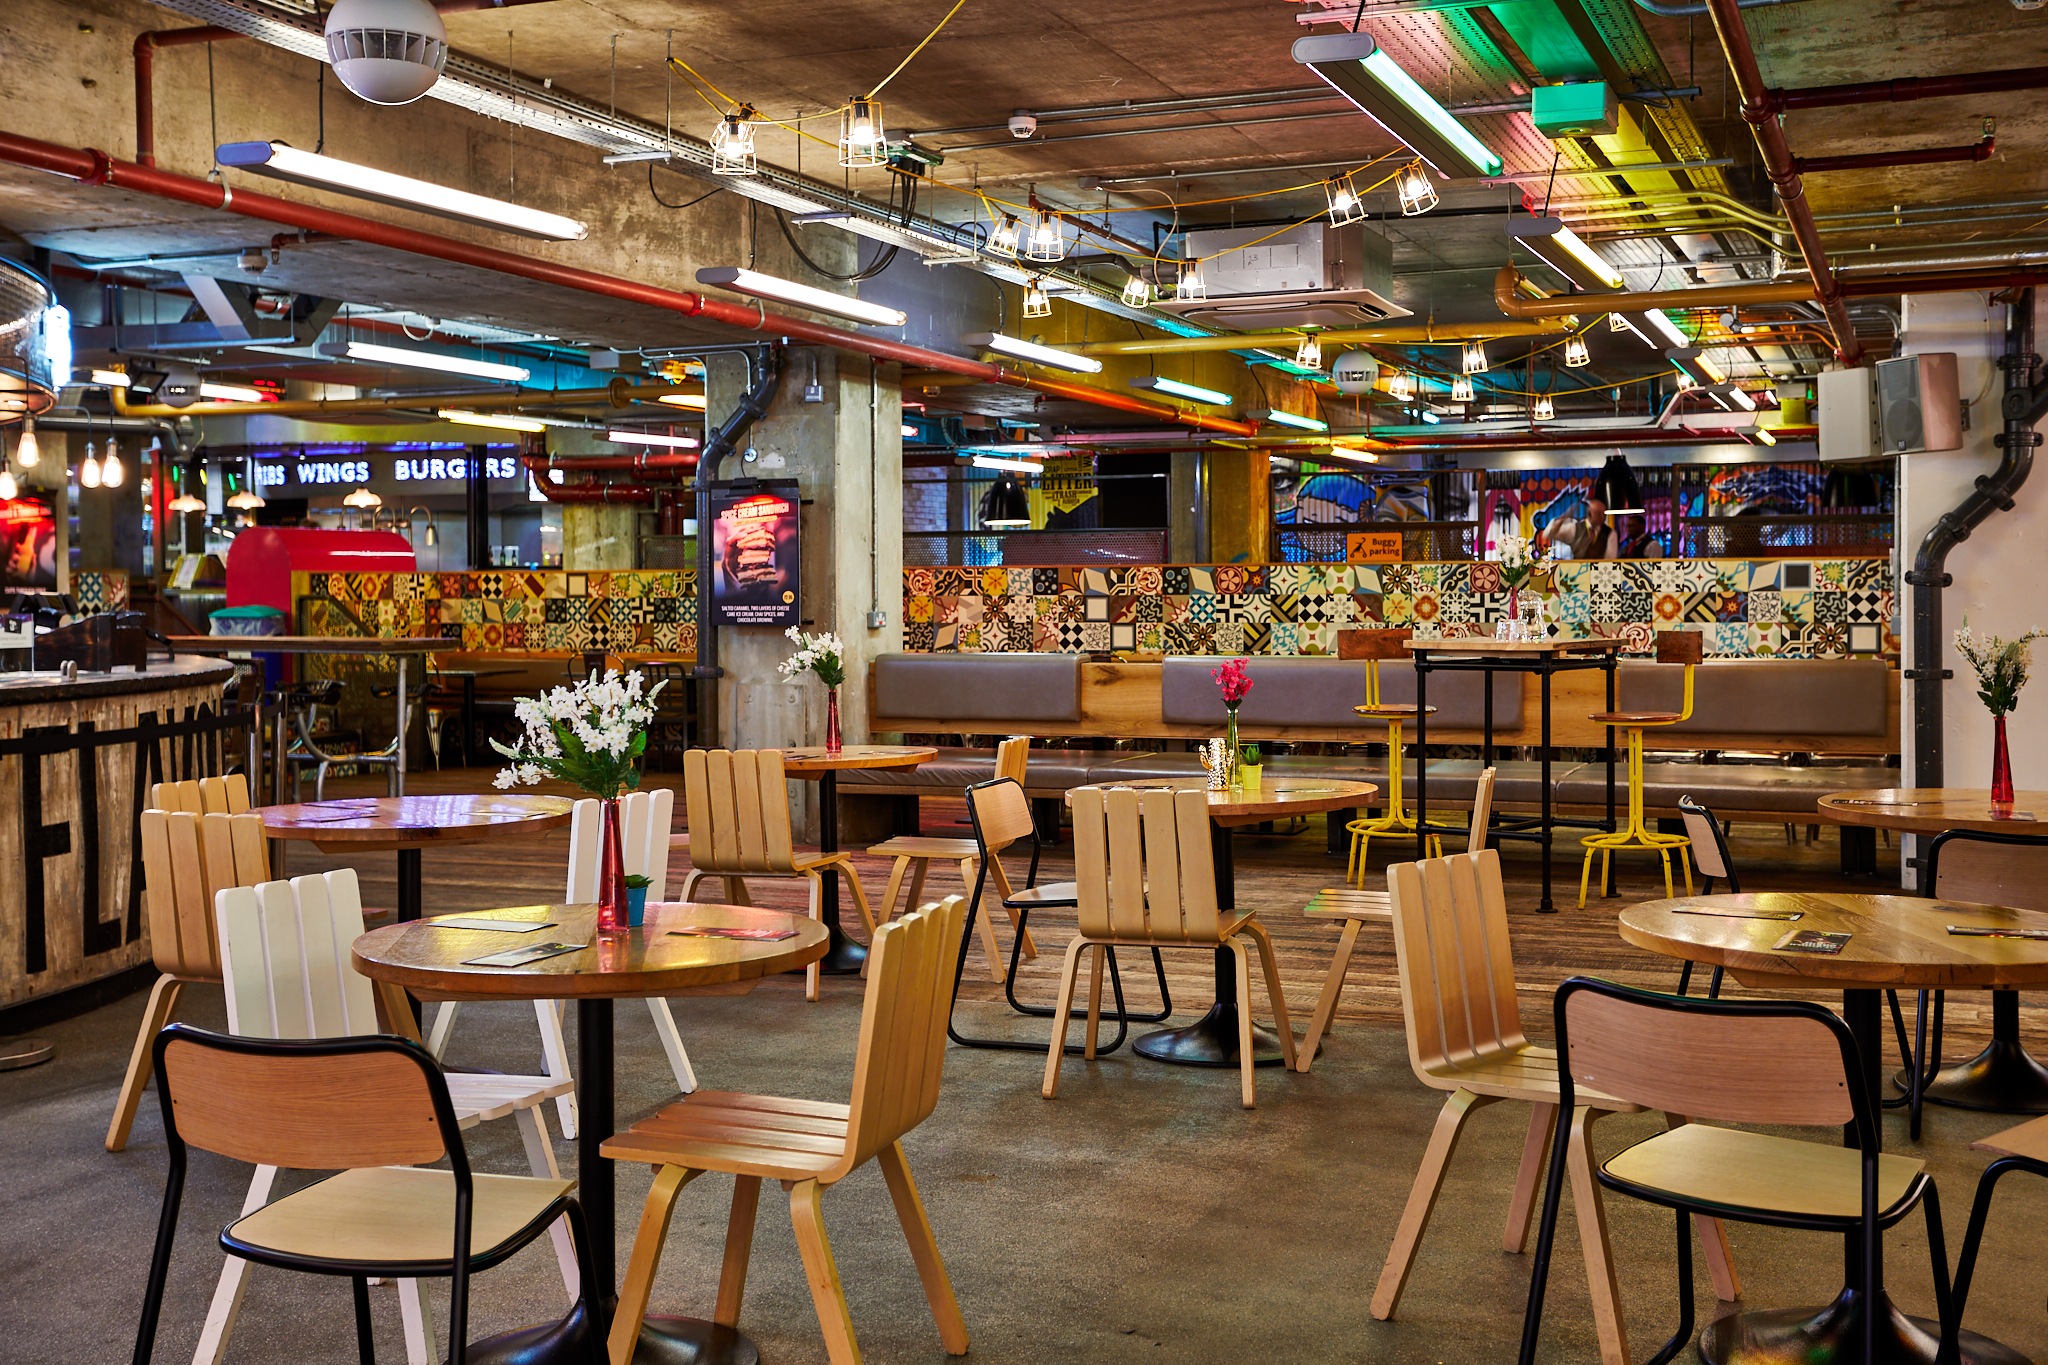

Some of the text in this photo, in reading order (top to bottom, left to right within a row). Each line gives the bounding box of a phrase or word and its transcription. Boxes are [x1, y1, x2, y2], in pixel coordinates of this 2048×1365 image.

[297, 461, 369, 484] WINGS
[395, 457, 516, 481] BURGRS
[1042, 472, 1093, 490] LITTER
[738, 506, 758, 518] CREAM
[758, 502, 790, 517] SANDWICH
[1372, 538, 1397, 548] Buggy
[1369, 547, 1400, 557] parking
